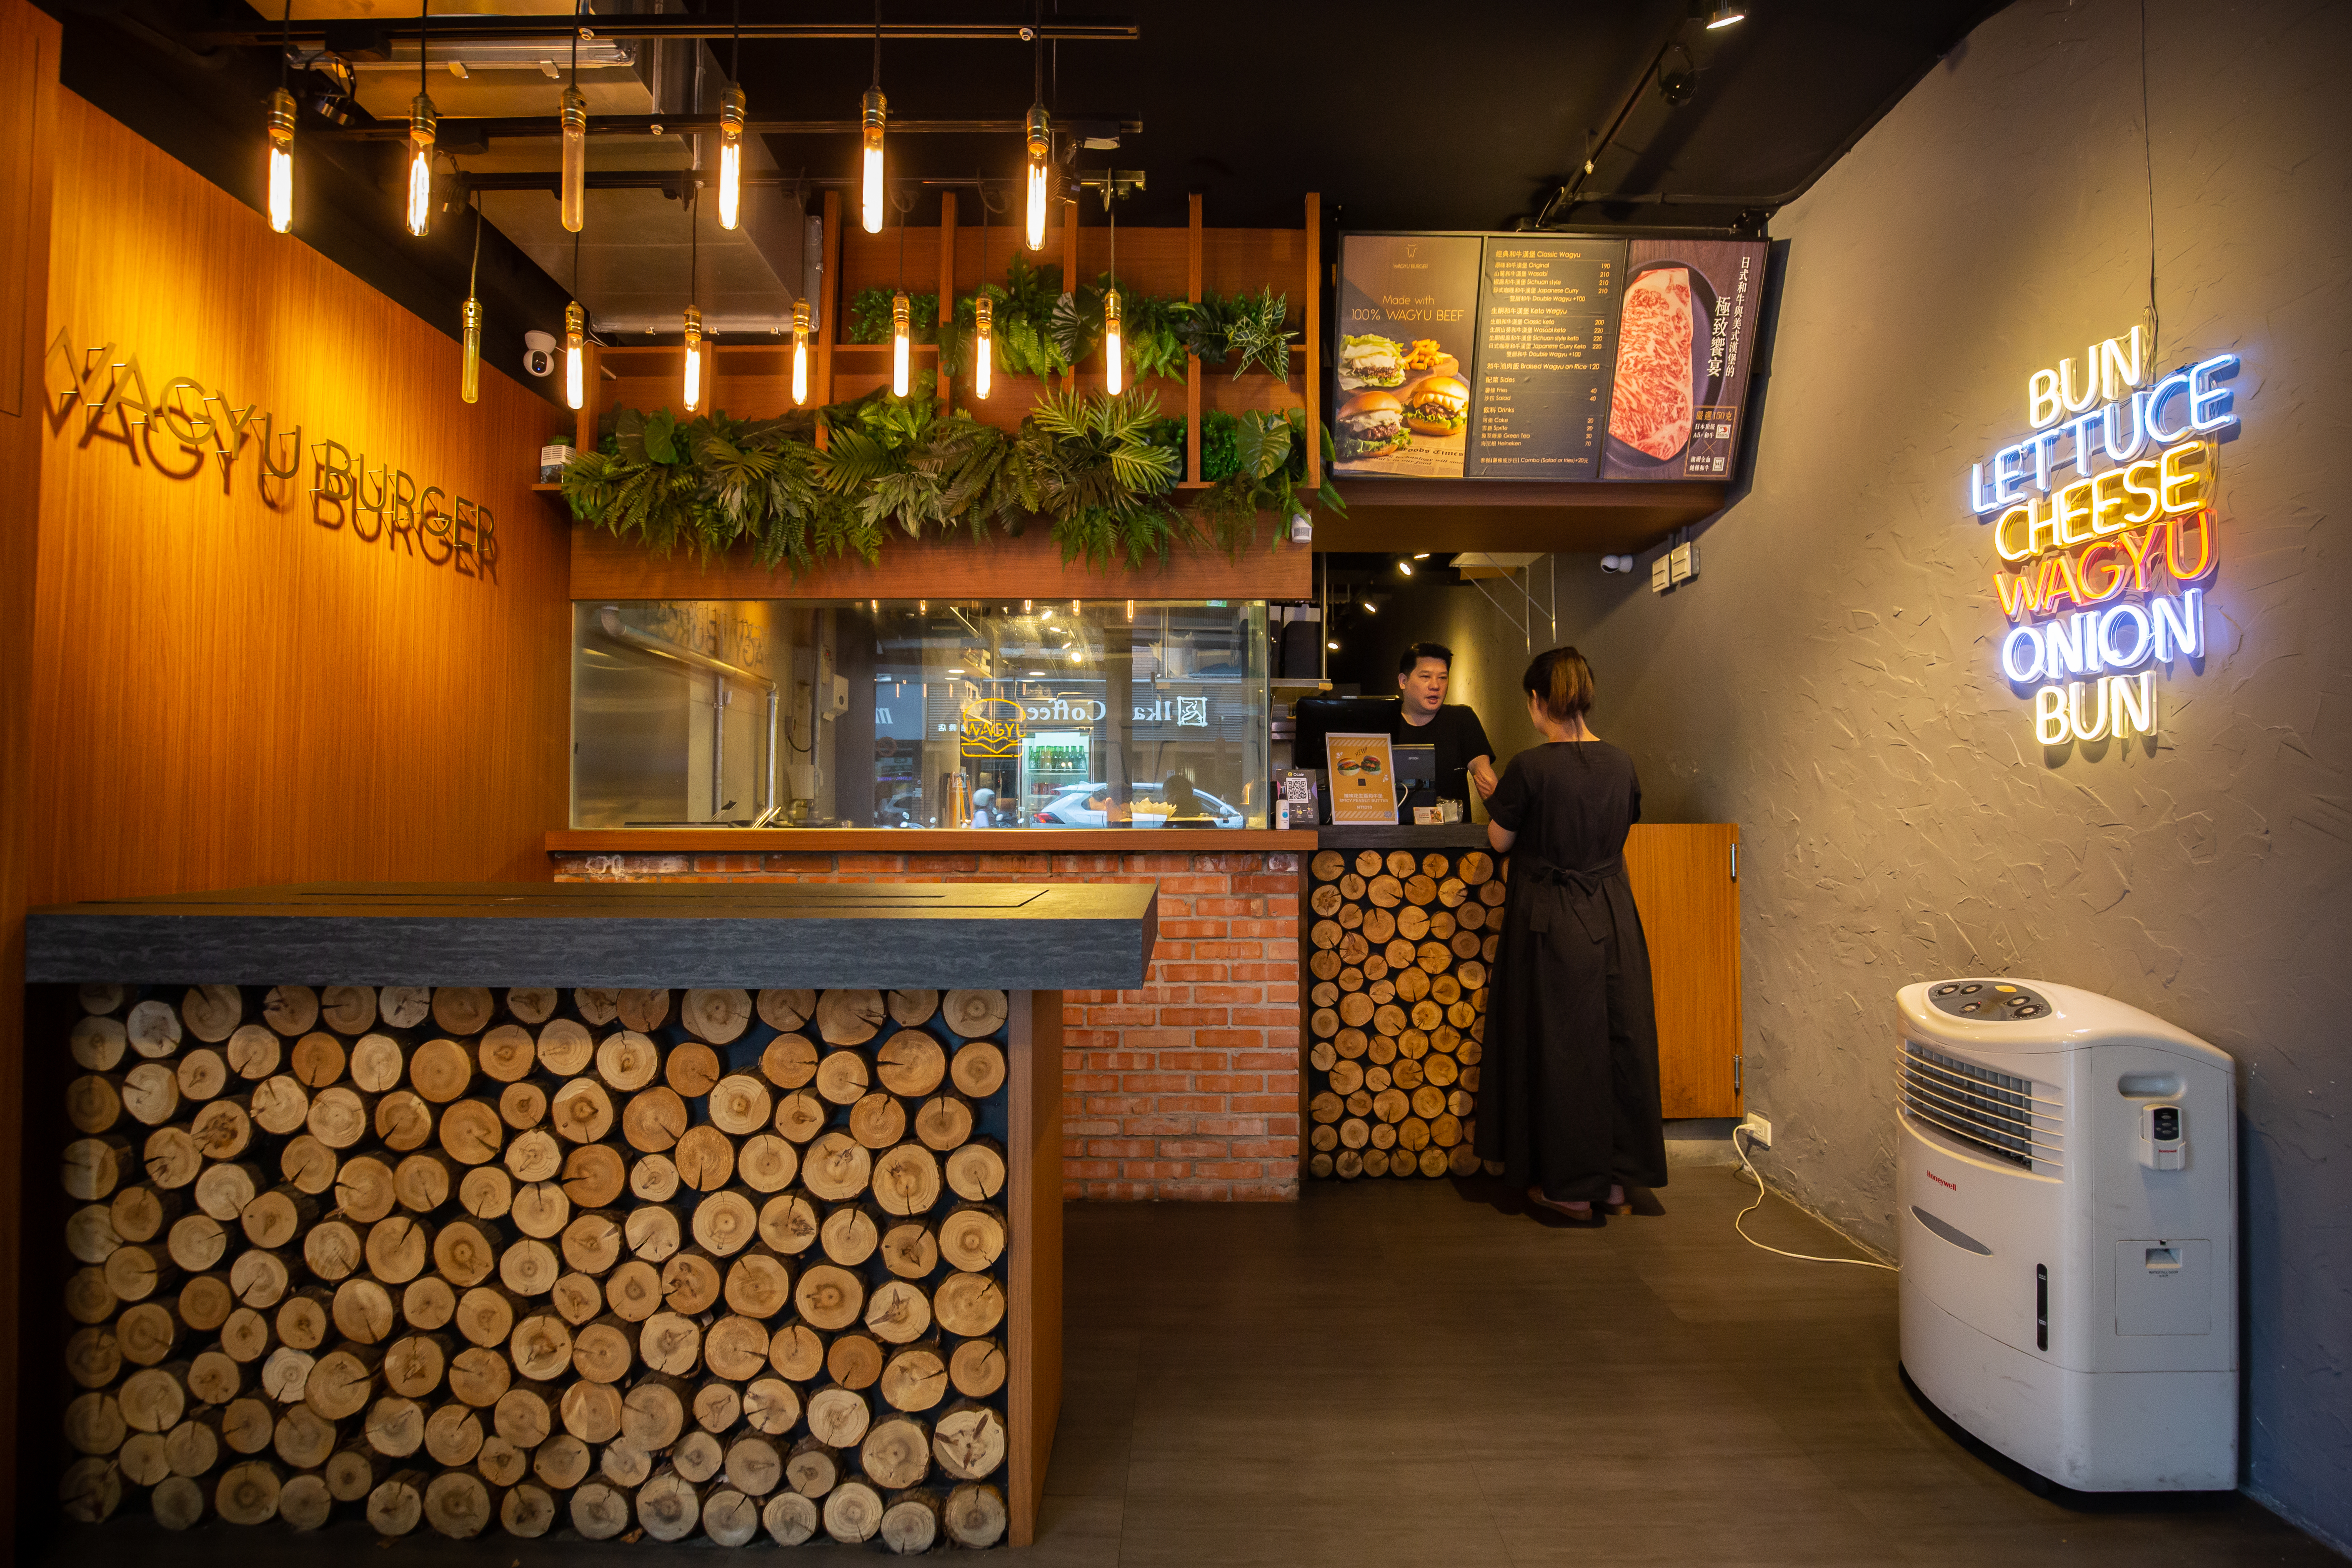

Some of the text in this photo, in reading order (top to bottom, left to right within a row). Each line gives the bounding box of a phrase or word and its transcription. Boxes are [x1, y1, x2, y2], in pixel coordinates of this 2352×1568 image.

[1352, 309, 1464, 321] 100% WAGYU BEEF
[1382, 295, 1434, 305] Made with
[1707, 296, 1731, 377] 極致饗宴
[1725, 256, 1750, 378] 日式和牛與美式漢堡的
[2029, 325, 2144, 431] BUN
[1971, 353, 2237, 515] LETTUCE
[324, 438, 495, 556] BURGER
[1994, 440, 2207, 562] CHEESE
[1993, 509, 2213, 616] WAGYU
[2002, 588, 2203, 683] ONION
[963, 723, 1027, 737] WAGYU
[2036, 671, 2157, 746] BUN
[1927, 1170, 1956, 1191] Honeywell
